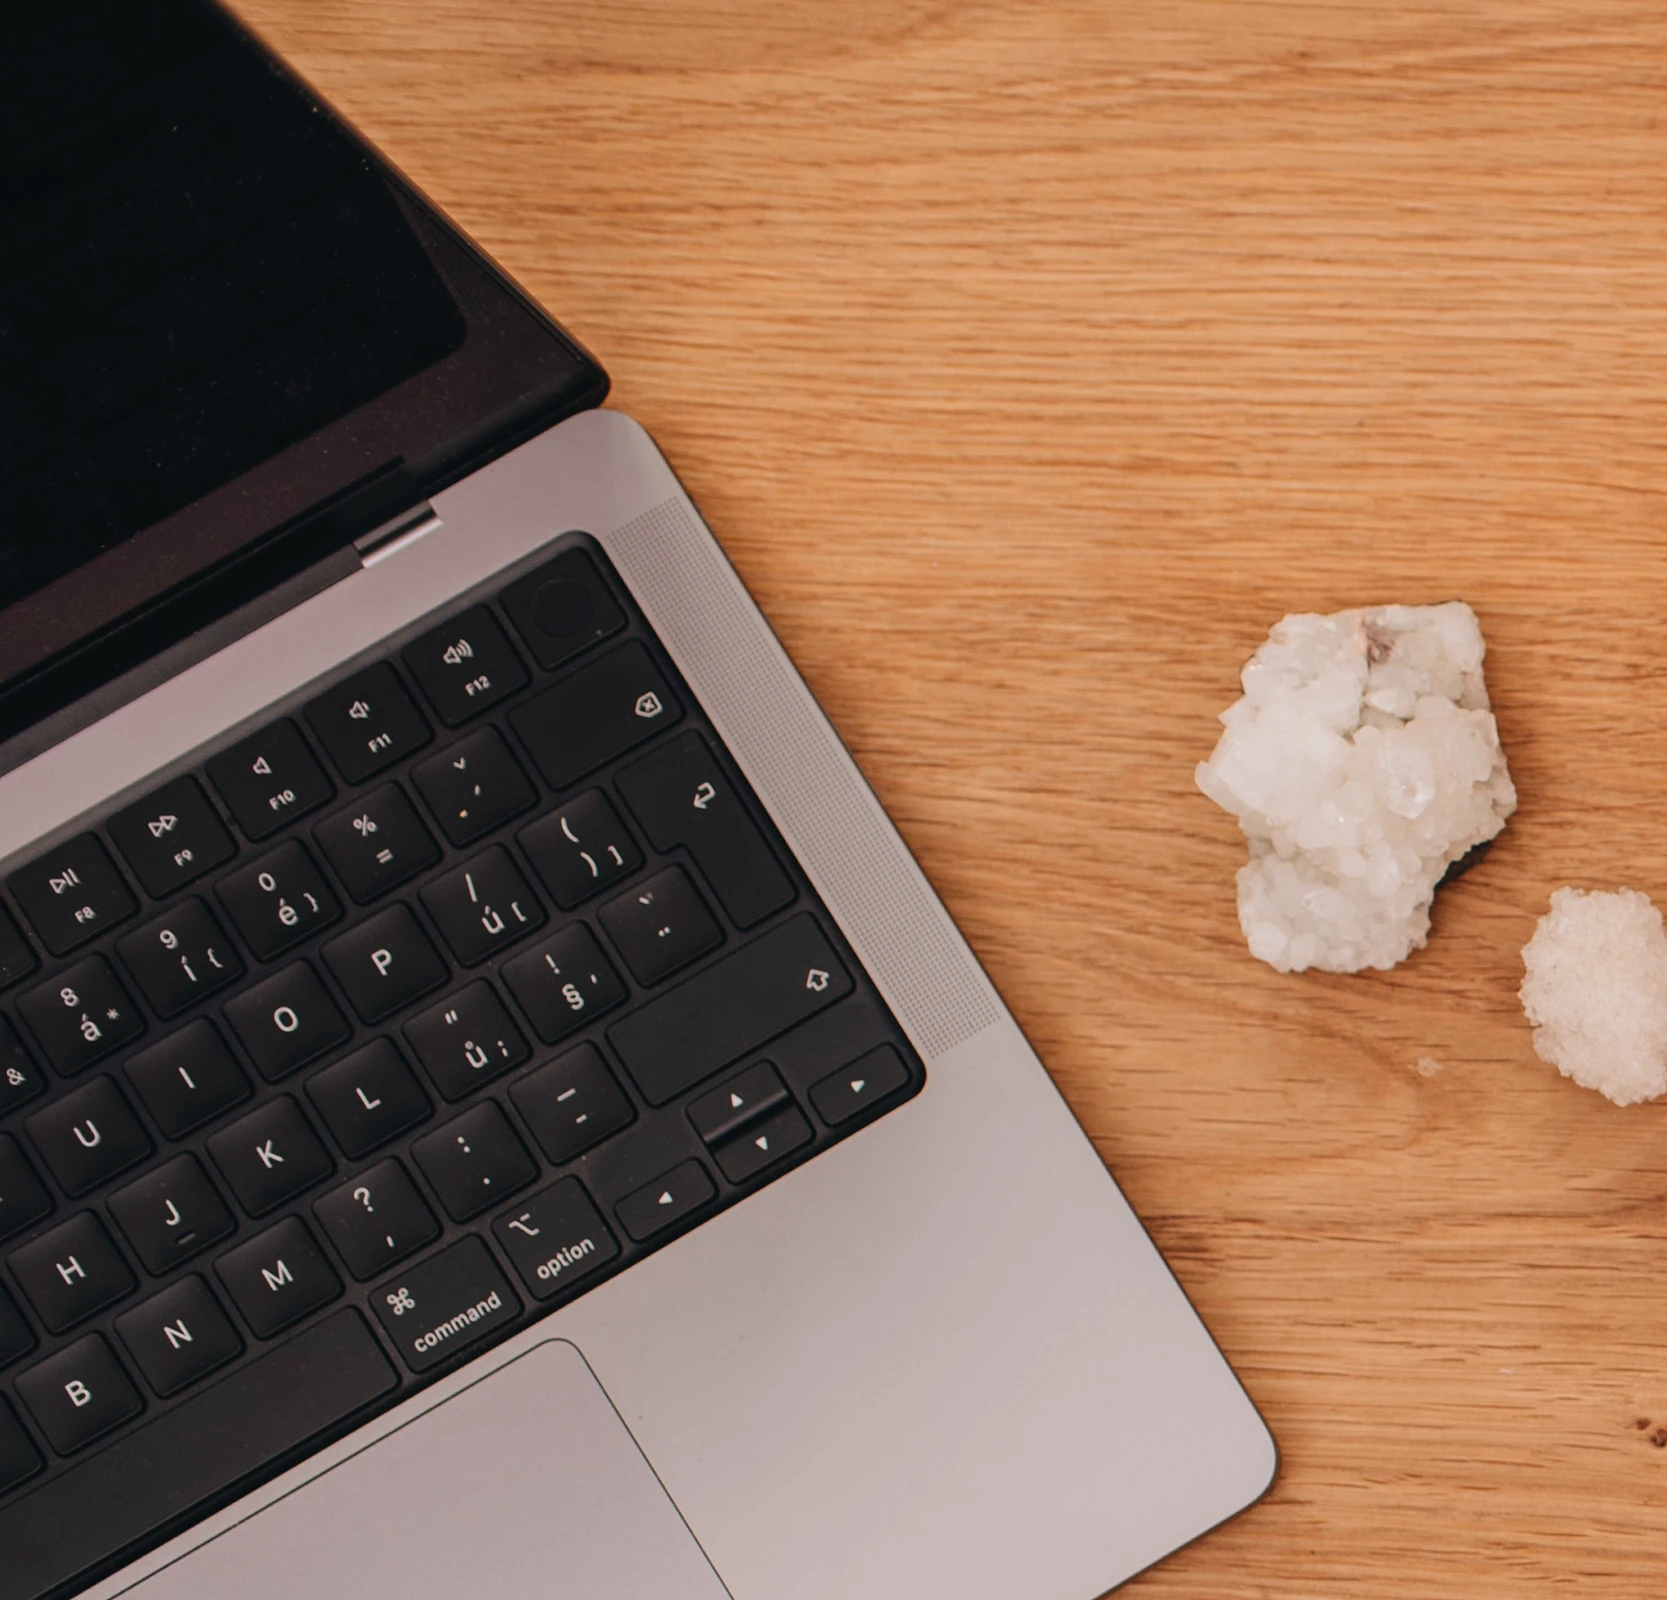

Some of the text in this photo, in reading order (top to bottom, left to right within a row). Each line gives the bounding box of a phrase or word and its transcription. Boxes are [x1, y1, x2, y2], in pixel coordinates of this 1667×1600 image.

[464, 675, 491, 697] F12
[367, 732, 392, 753] F11
[268, 789, 296, 811] F10
[352, 814, 378, 837] %
[173, 849, 193, 867] F9
[74, 906, 96, 924] F8
[278, 897, 299, 926] é
[481, 905, 505, 934] ú
[159, 929, 178, 950] 9
[371, 948, 392, 976] P
[60, 987, 80, 1007] 8
[561, 983, 585, 1011] §
[80, 1013, 103, 1042] á
[273, 1006, 299, 1033] O
[464, 1040, 489, 1069] ů
[6, 1067, 26, 1086] &
[355, 1087, 382, 1110] L
[72, 1119, 101, 1148] U
[255, 1139, 285, 1169] K
[165, 1199, 181, 1226] J
[353, 1186, 374, 1213] ?
[55, 1255, 86, 1285] H
[536, 1238, 596, 1280] option
[261, 1259, 294, 1292] M
[163, 1319, 193, 1349] N
[414, 1290, 502, 1353] command
[64, 1379, 92, 1407] B
